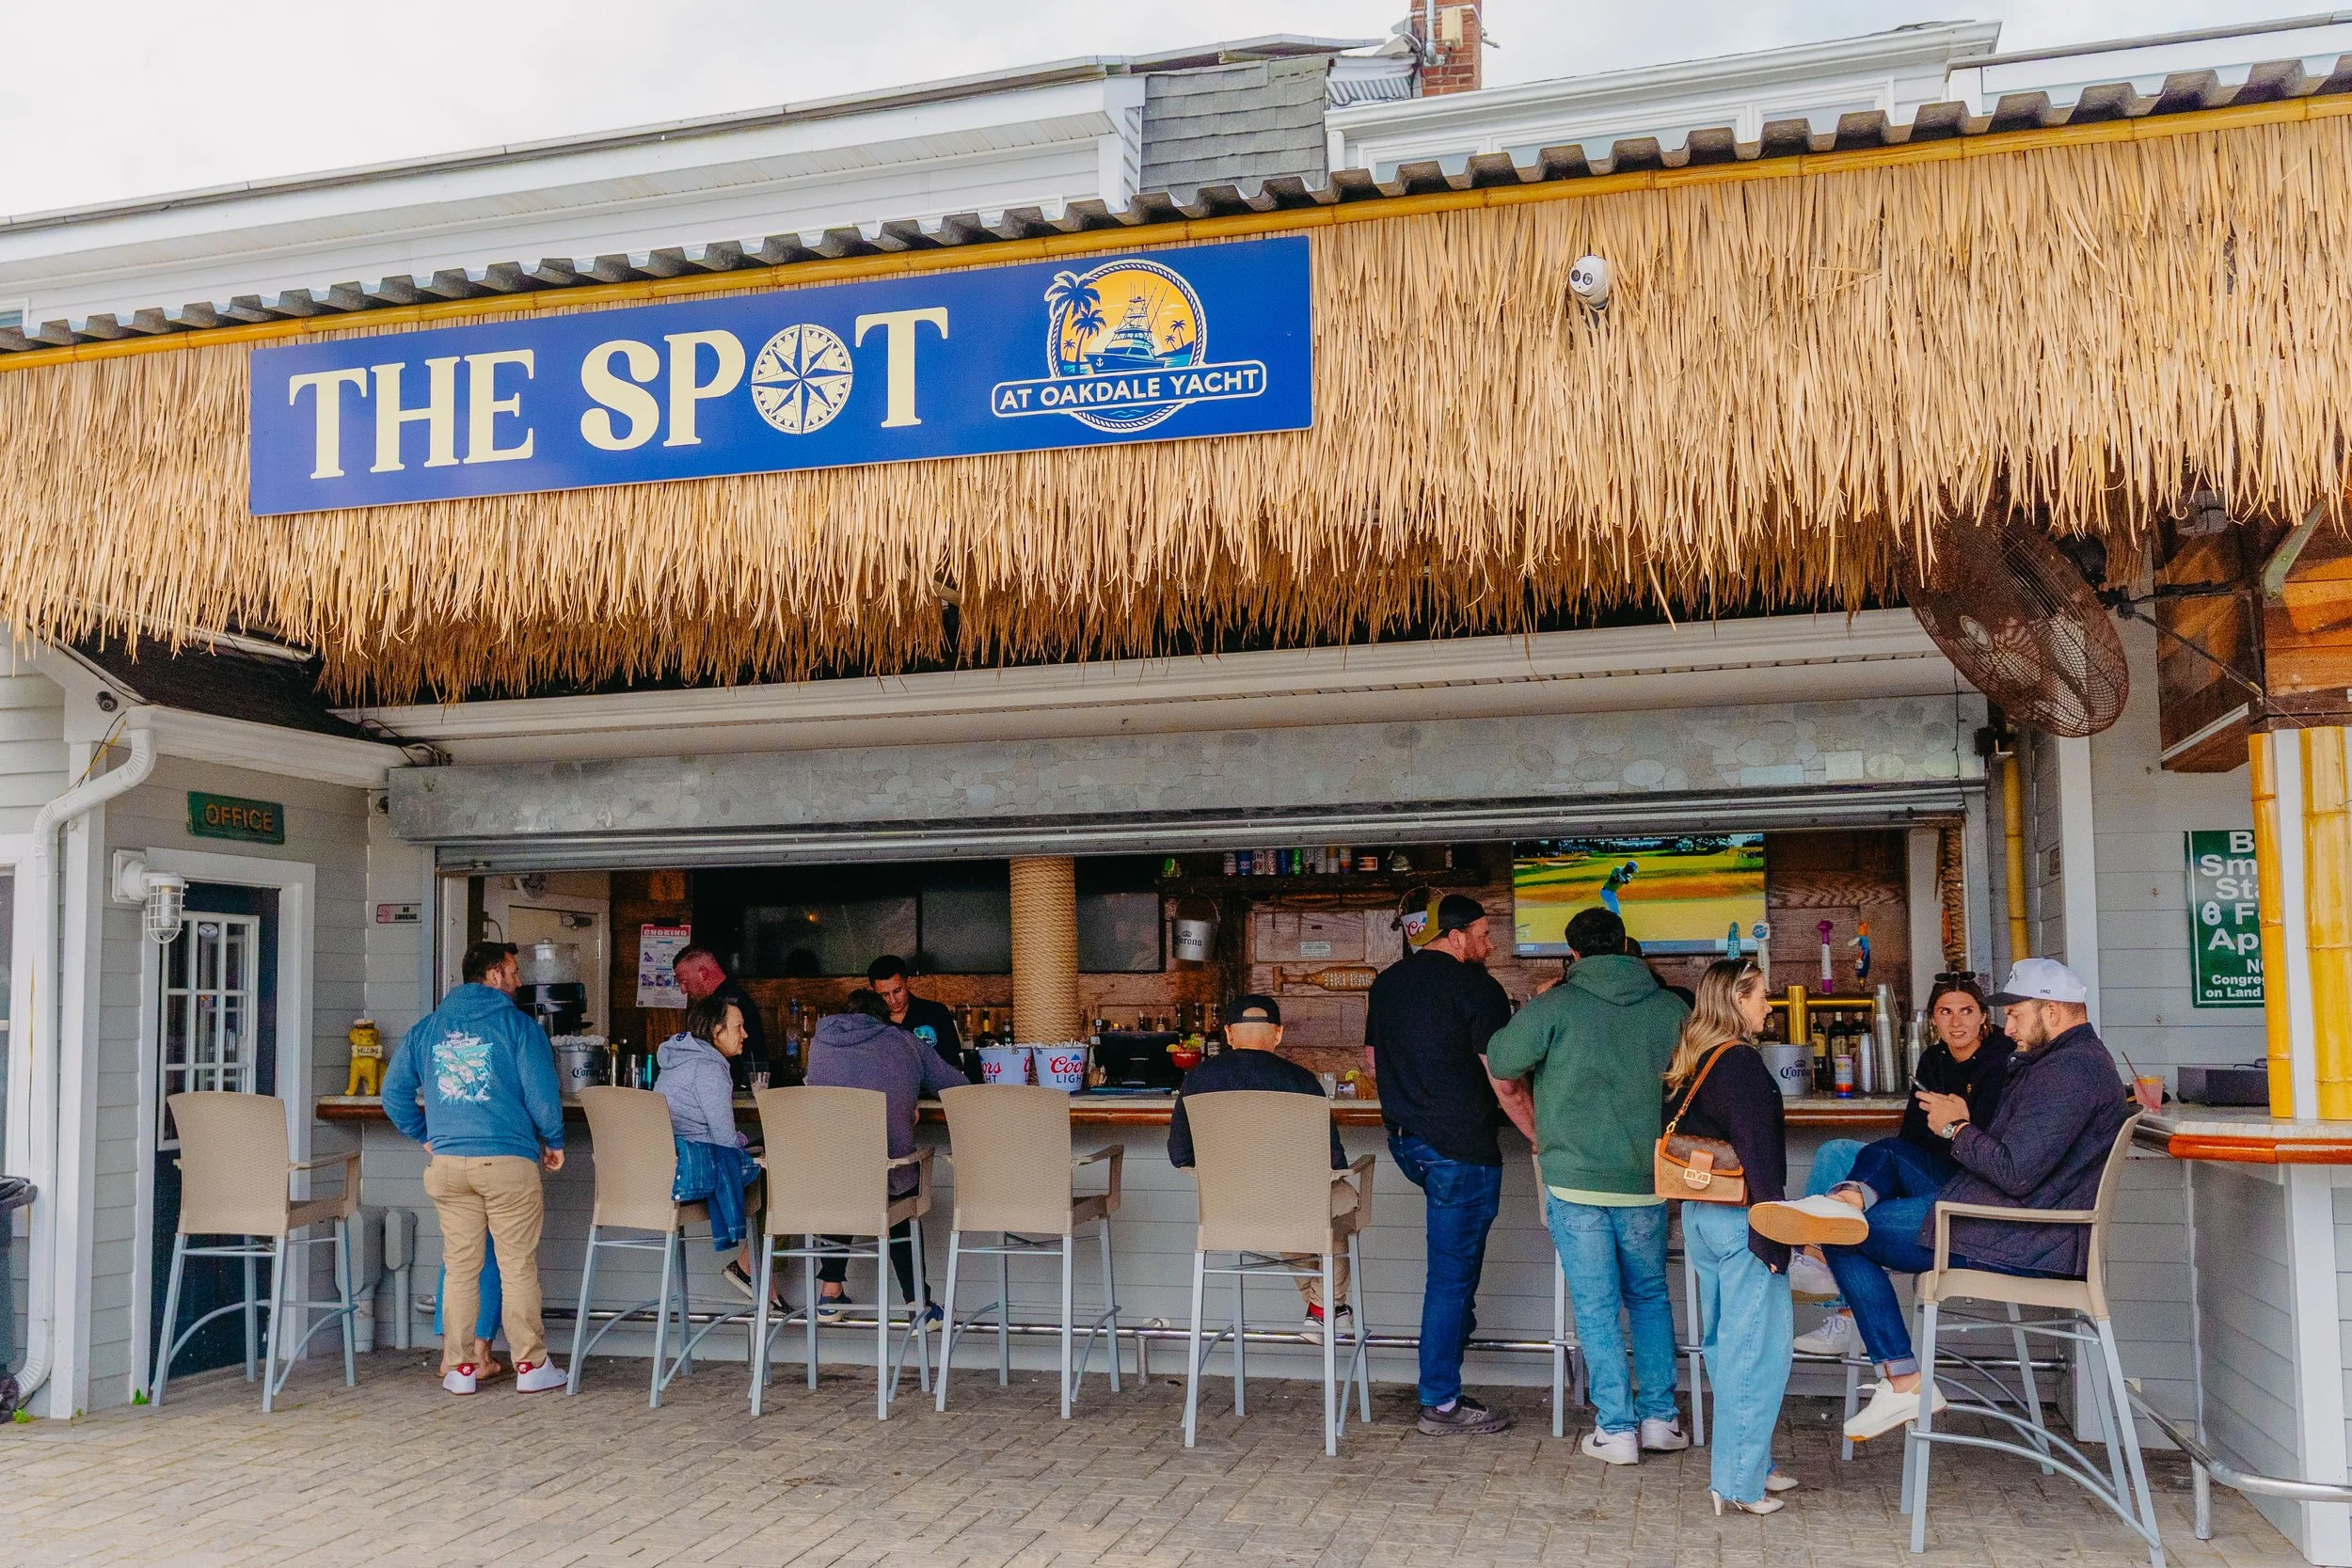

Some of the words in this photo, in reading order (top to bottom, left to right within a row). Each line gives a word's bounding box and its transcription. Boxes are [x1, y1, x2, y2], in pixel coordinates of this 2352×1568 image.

[289, 349, 534, 479] THE
[580, 307, 947, 451] SPOT
[999, 388, 1032, 410] AT
[1041, 377, 1160, 406] OAKDALE
[1169, 370, 1260, 395] YACHT
[204, 803, 273, 832] OFFICE
[2229, 832, 2255, 854] B
[2216, 878, 2260, 900] St
[2246, 958, 2265, 974] N
[2211, 974, 2265, 987] Congre
[2227, 987, 2262, 997] Land
[1049, 1055, 1084, 1073] Coo
[1056, 1074, 1082, 1084] LIGH
